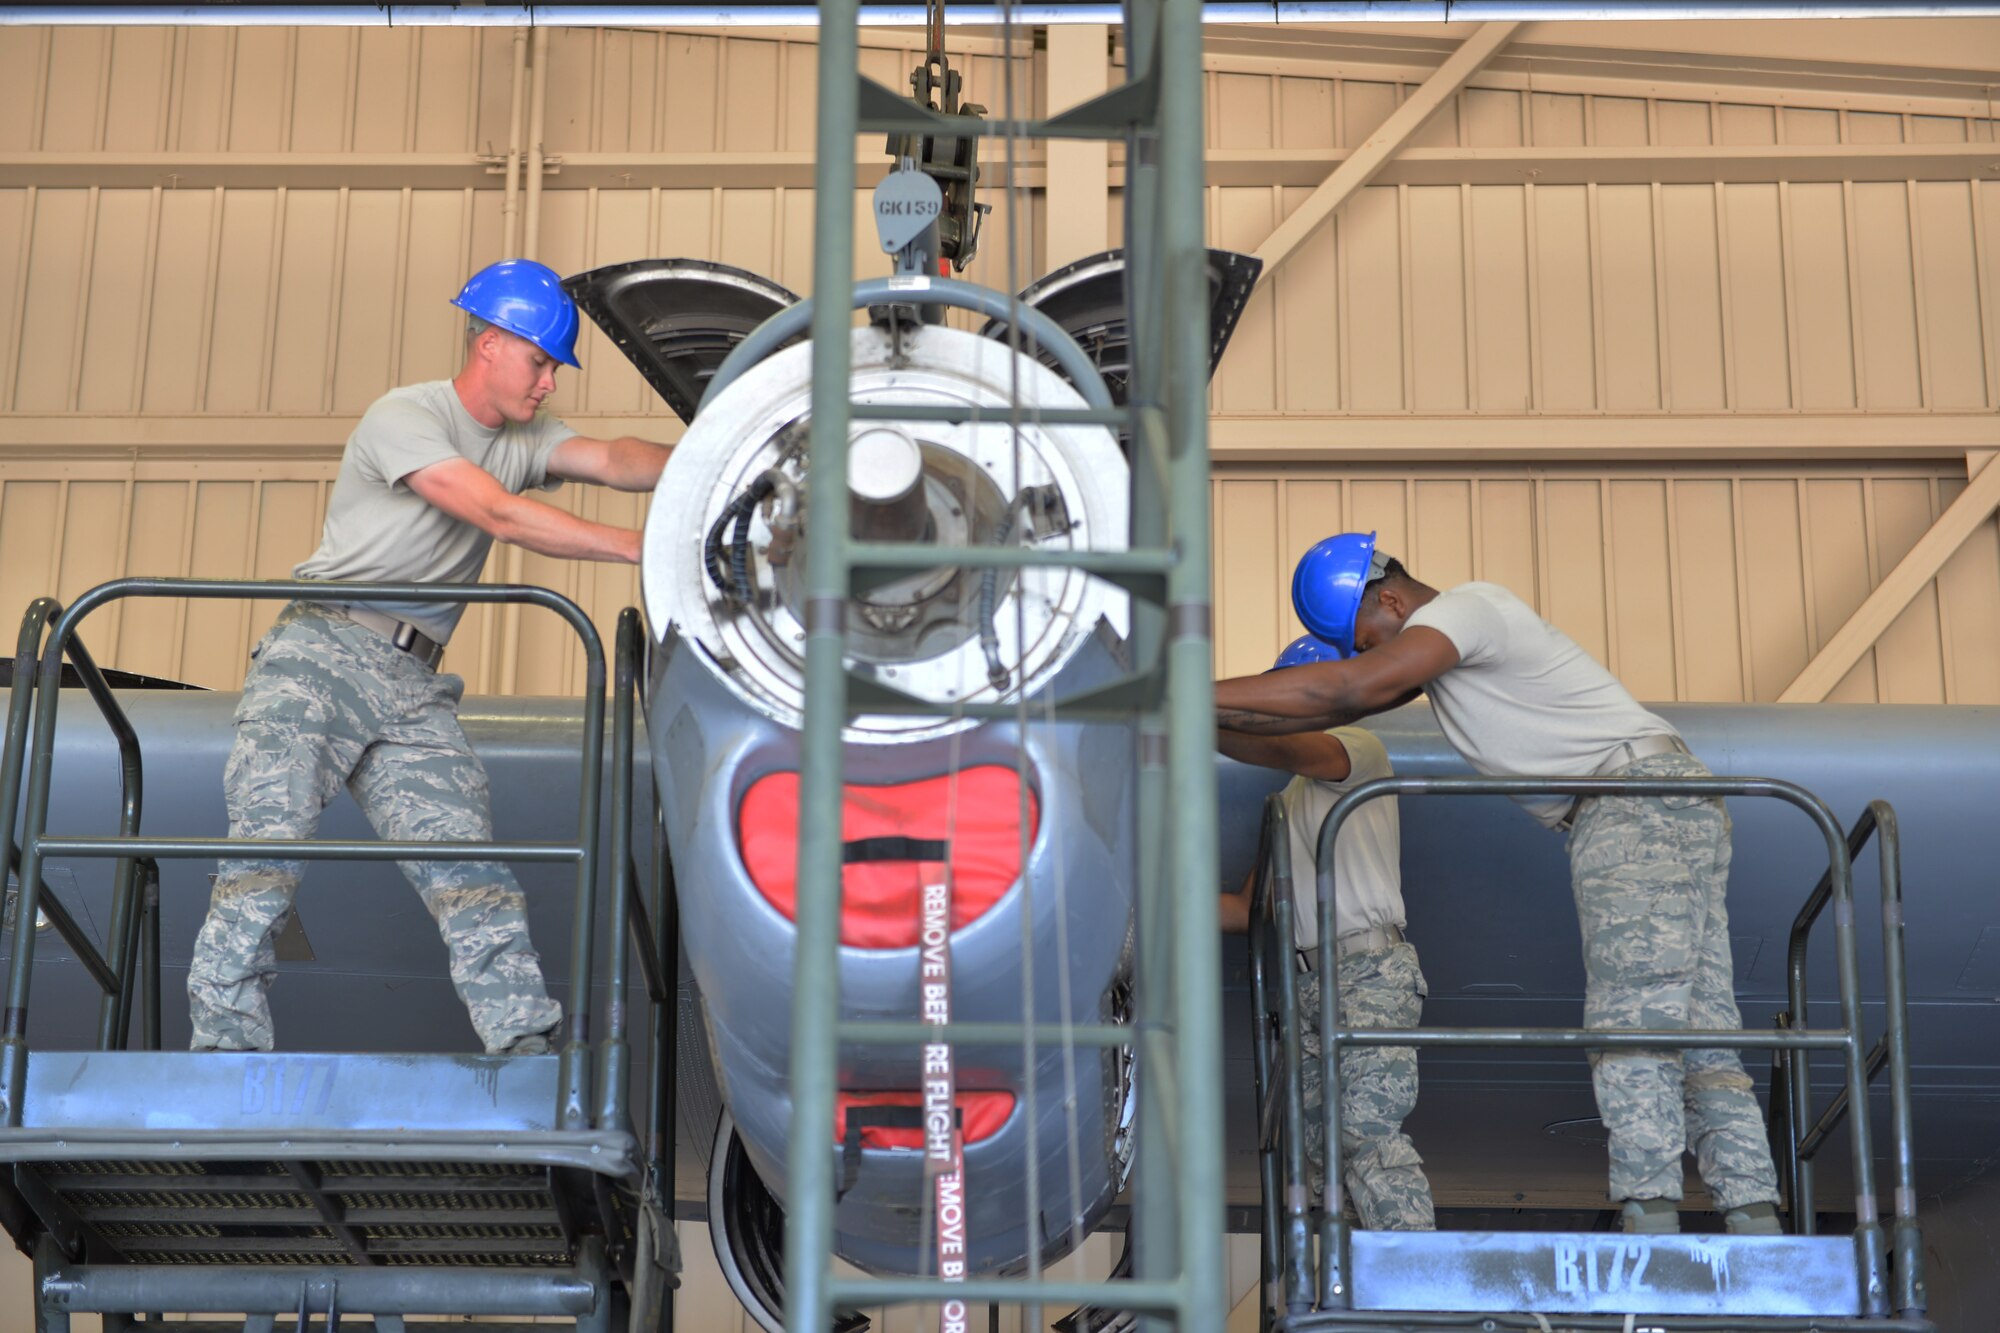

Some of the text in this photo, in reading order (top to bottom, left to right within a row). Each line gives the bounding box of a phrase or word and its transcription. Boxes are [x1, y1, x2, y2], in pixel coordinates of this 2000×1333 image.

[879, 201, 938, 215] GK159
[922, 884, 950, 1161] REMOVE BEFRE FLIGHT
[1555, 1239, 1652, 1293] B172
